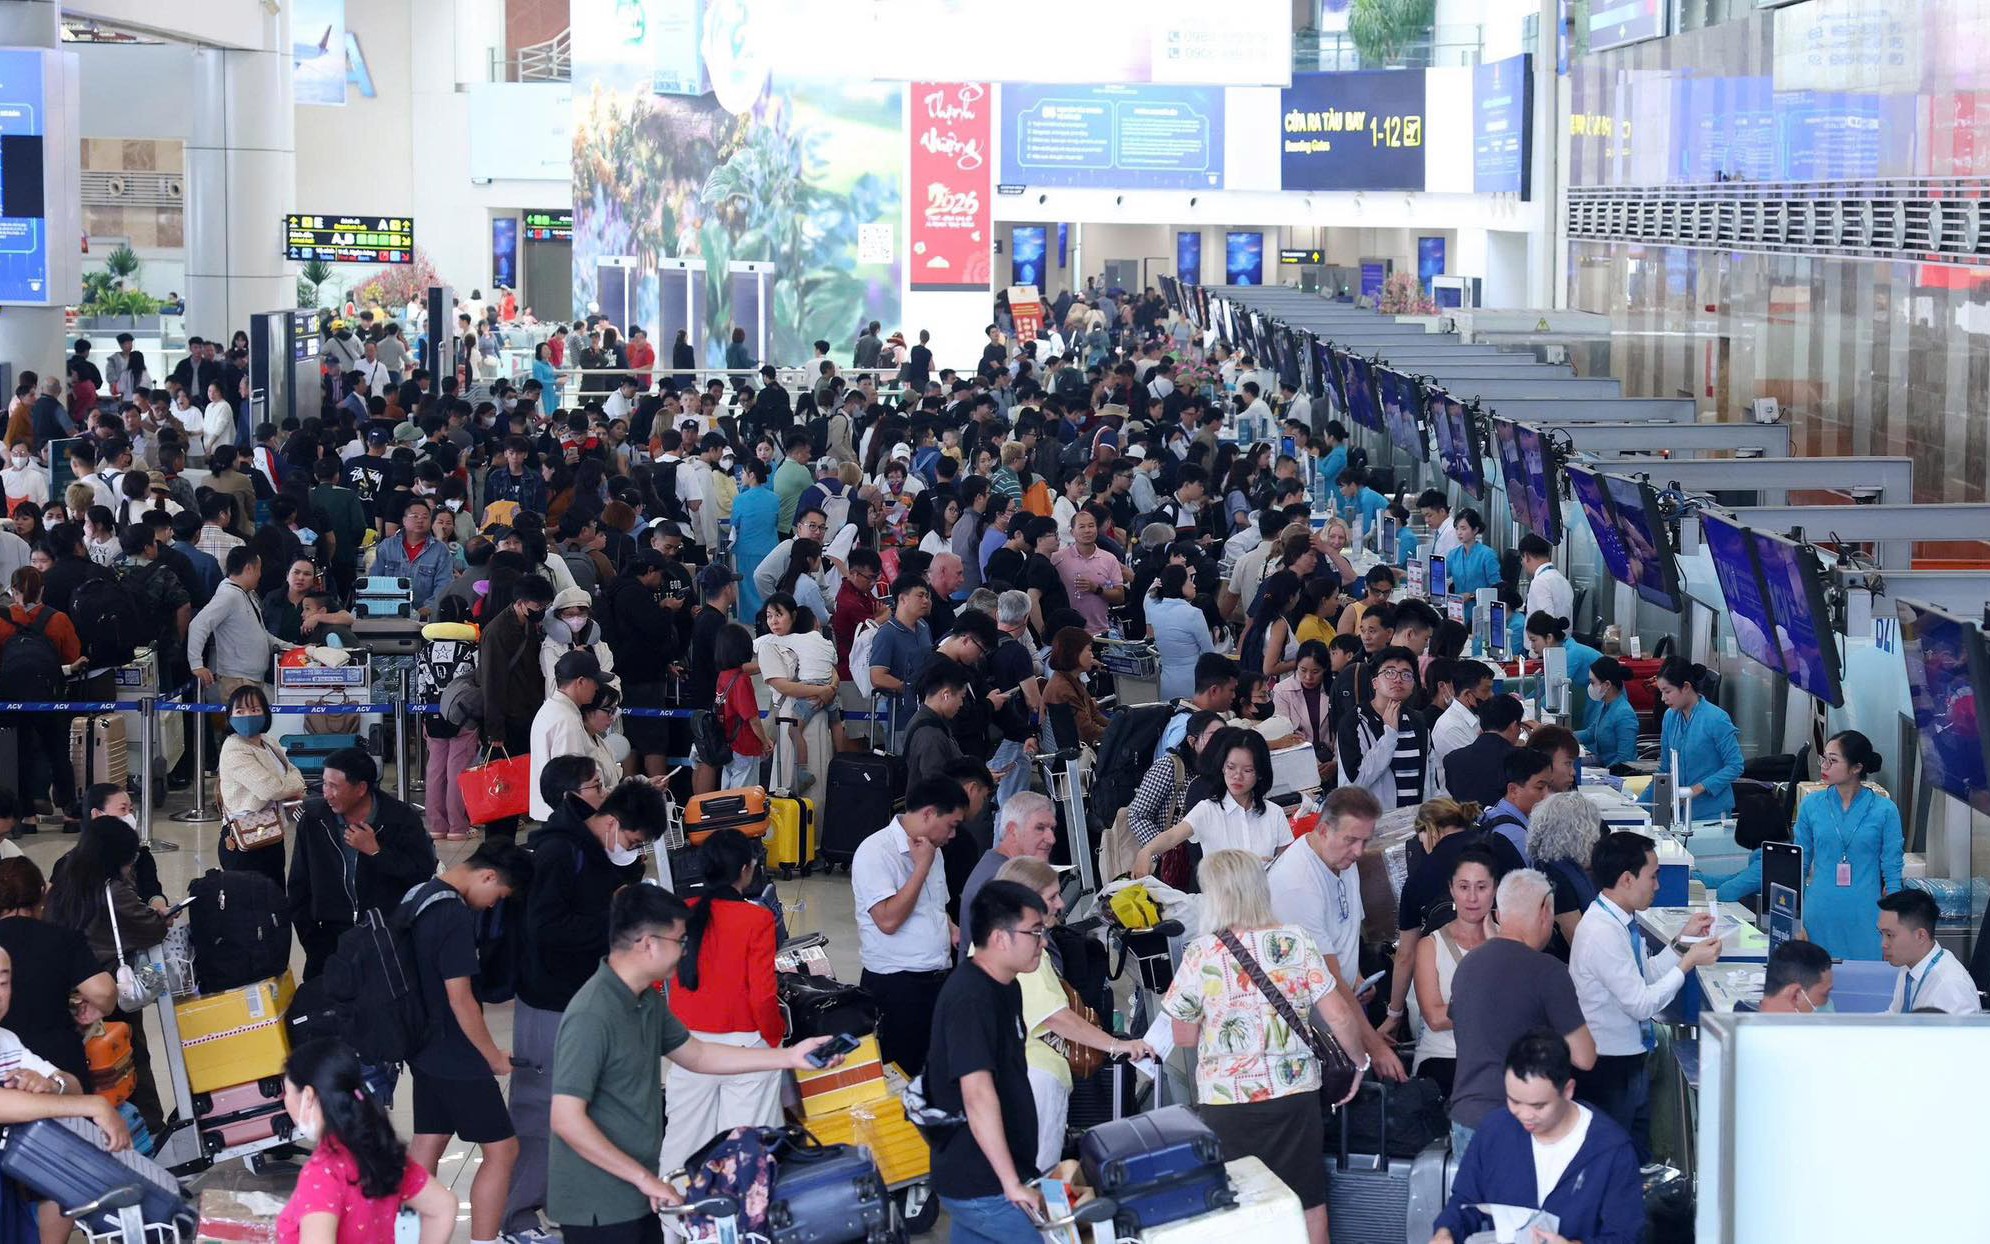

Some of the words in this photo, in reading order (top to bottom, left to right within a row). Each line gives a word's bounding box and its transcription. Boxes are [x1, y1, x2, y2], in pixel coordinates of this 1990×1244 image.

[1370, 116, 1401, 147] 1-12
[925, 182, 979, 216] 2026
[314, 217, 324, 229] E
[378, 219, 389, 231] A
